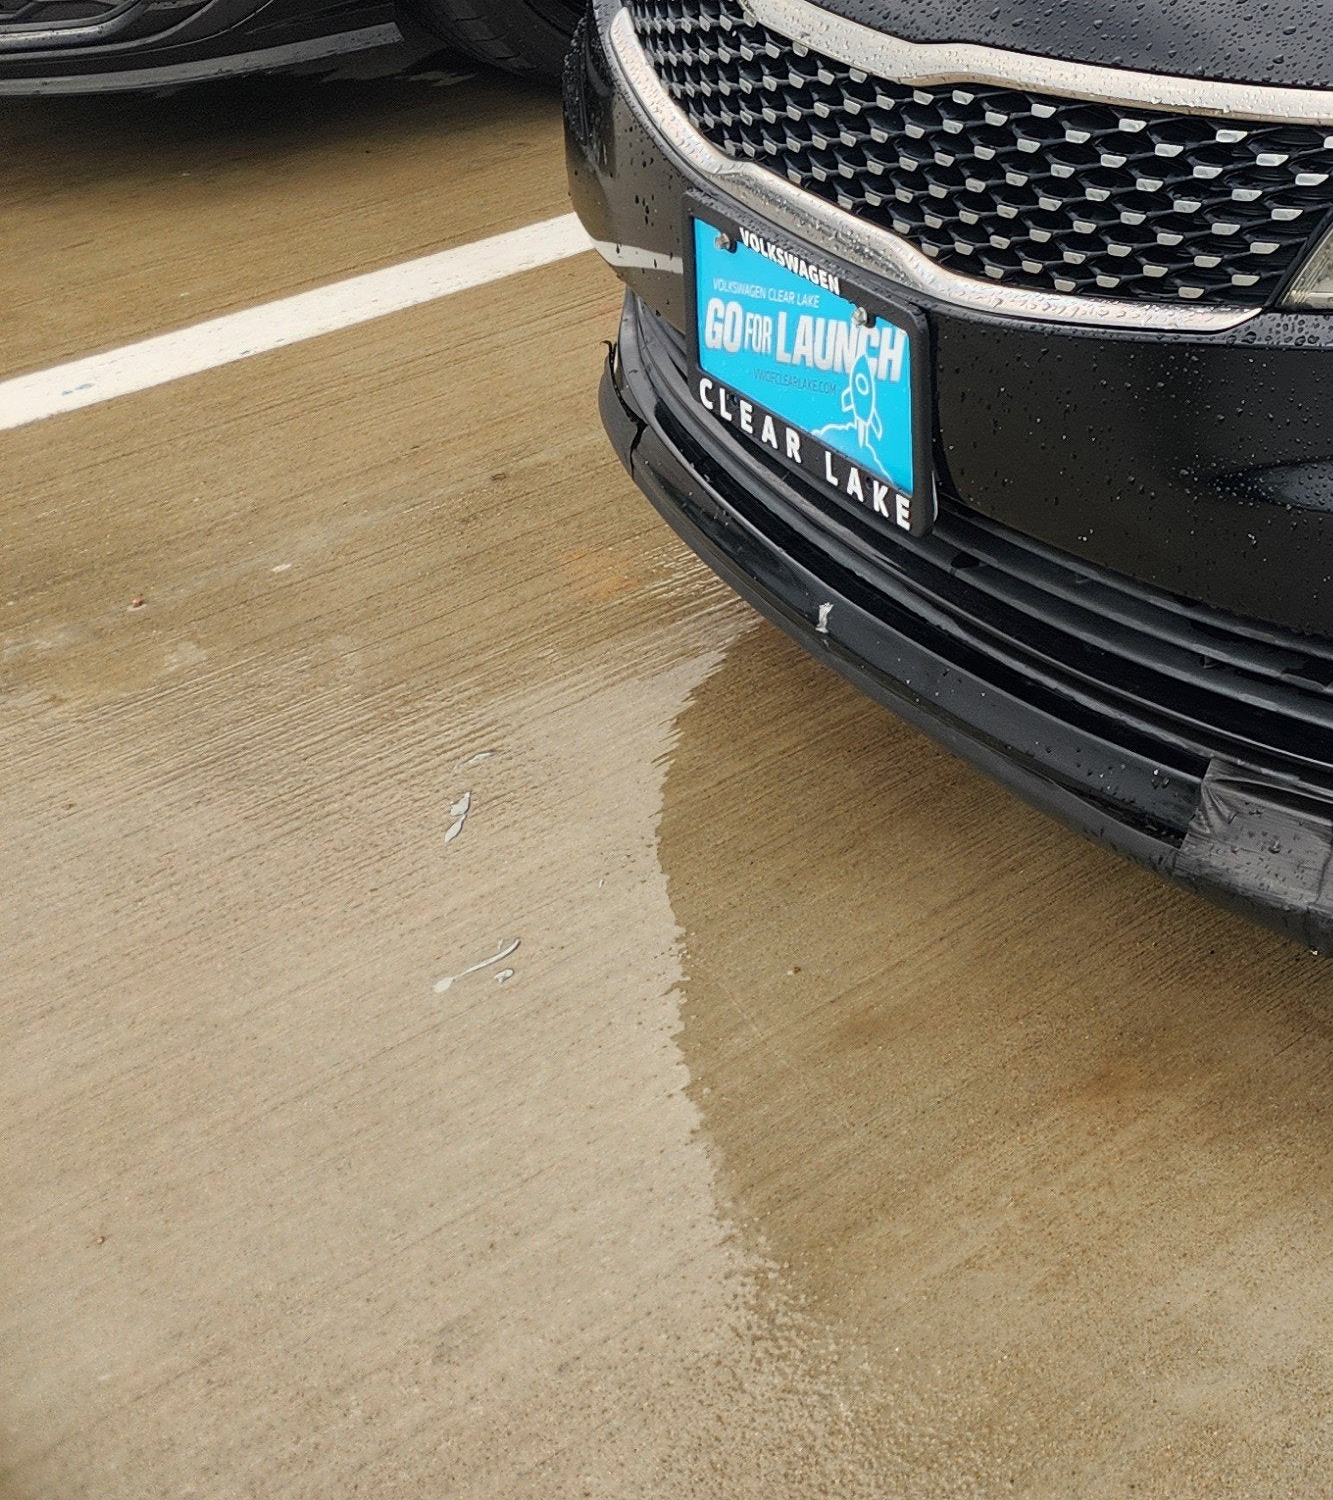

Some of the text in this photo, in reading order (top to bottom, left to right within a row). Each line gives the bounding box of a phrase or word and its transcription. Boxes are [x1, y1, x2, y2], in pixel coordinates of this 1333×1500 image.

[713, 279, 820, 309] VOLKSWAGEN CLEAR LAKE
[740, 227, 840, 296] VOLKSWAGEN
[706, 298, 905, 382] GO FOR LAUNCH
[699, 378, 912, 531] CLEAR LAKE
